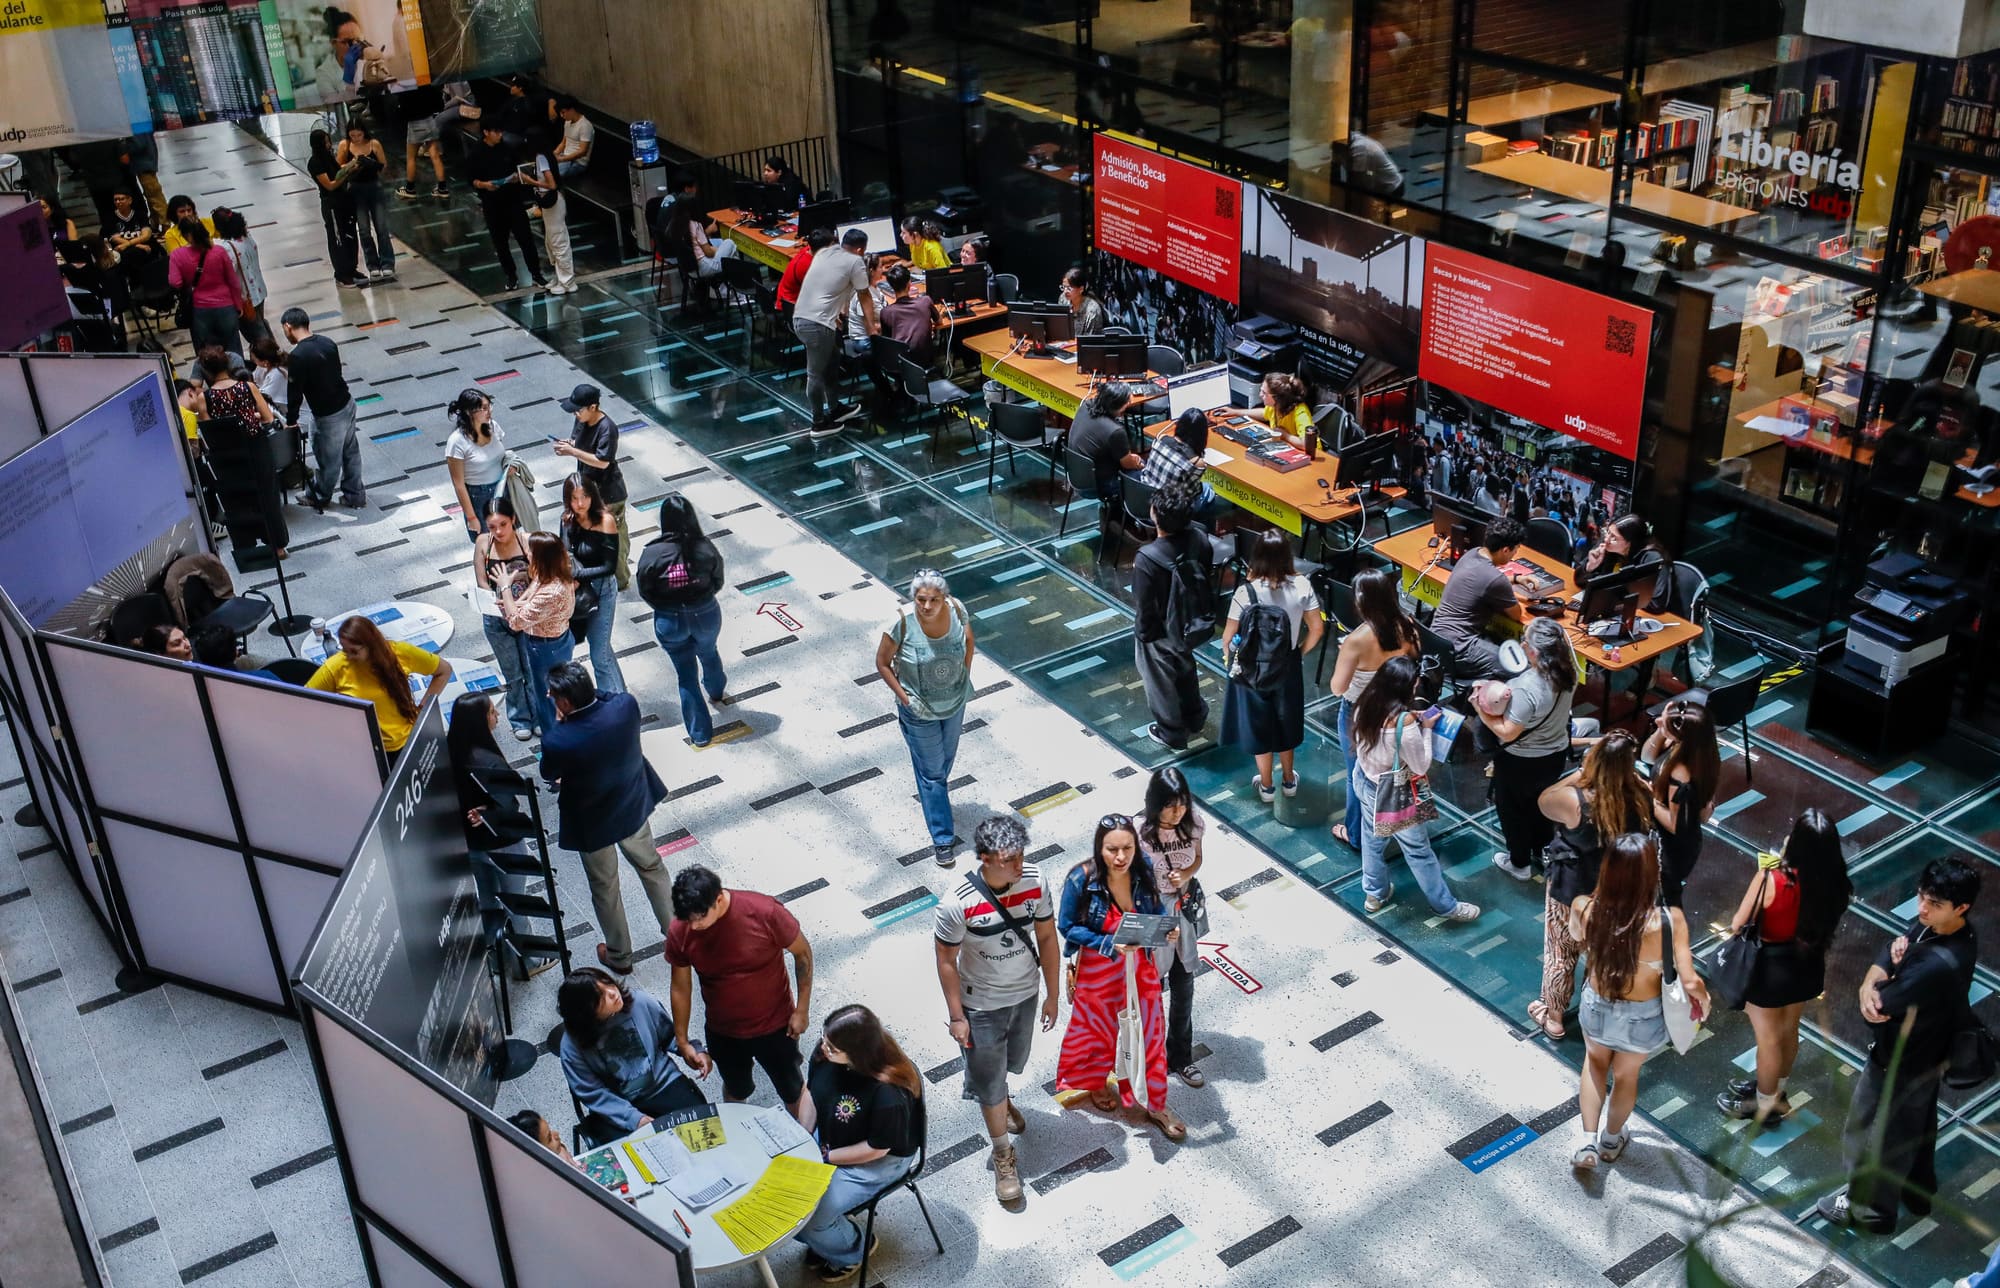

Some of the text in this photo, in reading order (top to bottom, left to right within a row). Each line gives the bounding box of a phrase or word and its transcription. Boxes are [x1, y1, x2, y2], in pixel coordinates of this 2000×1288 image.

[4, 1, 25, 15] del
[165, 10, 185, 18] Pasa
[208, 5, 224, 14] udp
[1101, 150, 1166, 183] Admisión, Becas
[1719, 126, 1860, 190] Librería
[1101, 164, 1149, 190] y Beneficios
[1715, 168, 1852, 222] EDICIONES udp
[1433, 266, 1452, 278] Becas
[1458, 274, 1491, 291] beneficios
[1300, 326, 1353, 355] Pasa en la udp
[1030, 379, 1049, 400] Diego
[1050, 391, 1077, 412] Portales
[1565, 414, 1587, 433] udp
[1226, 480, 1249, 501] Diego
[1251, 494, 1284, 519] Portales
[395, 768, 423, 841] 246
[1152, 839, 1193, 853] RAMONES
[1212, 956, 1250, 987] SALIDA
[1472, 1131, 1527, 1166] Participa en la UDP
